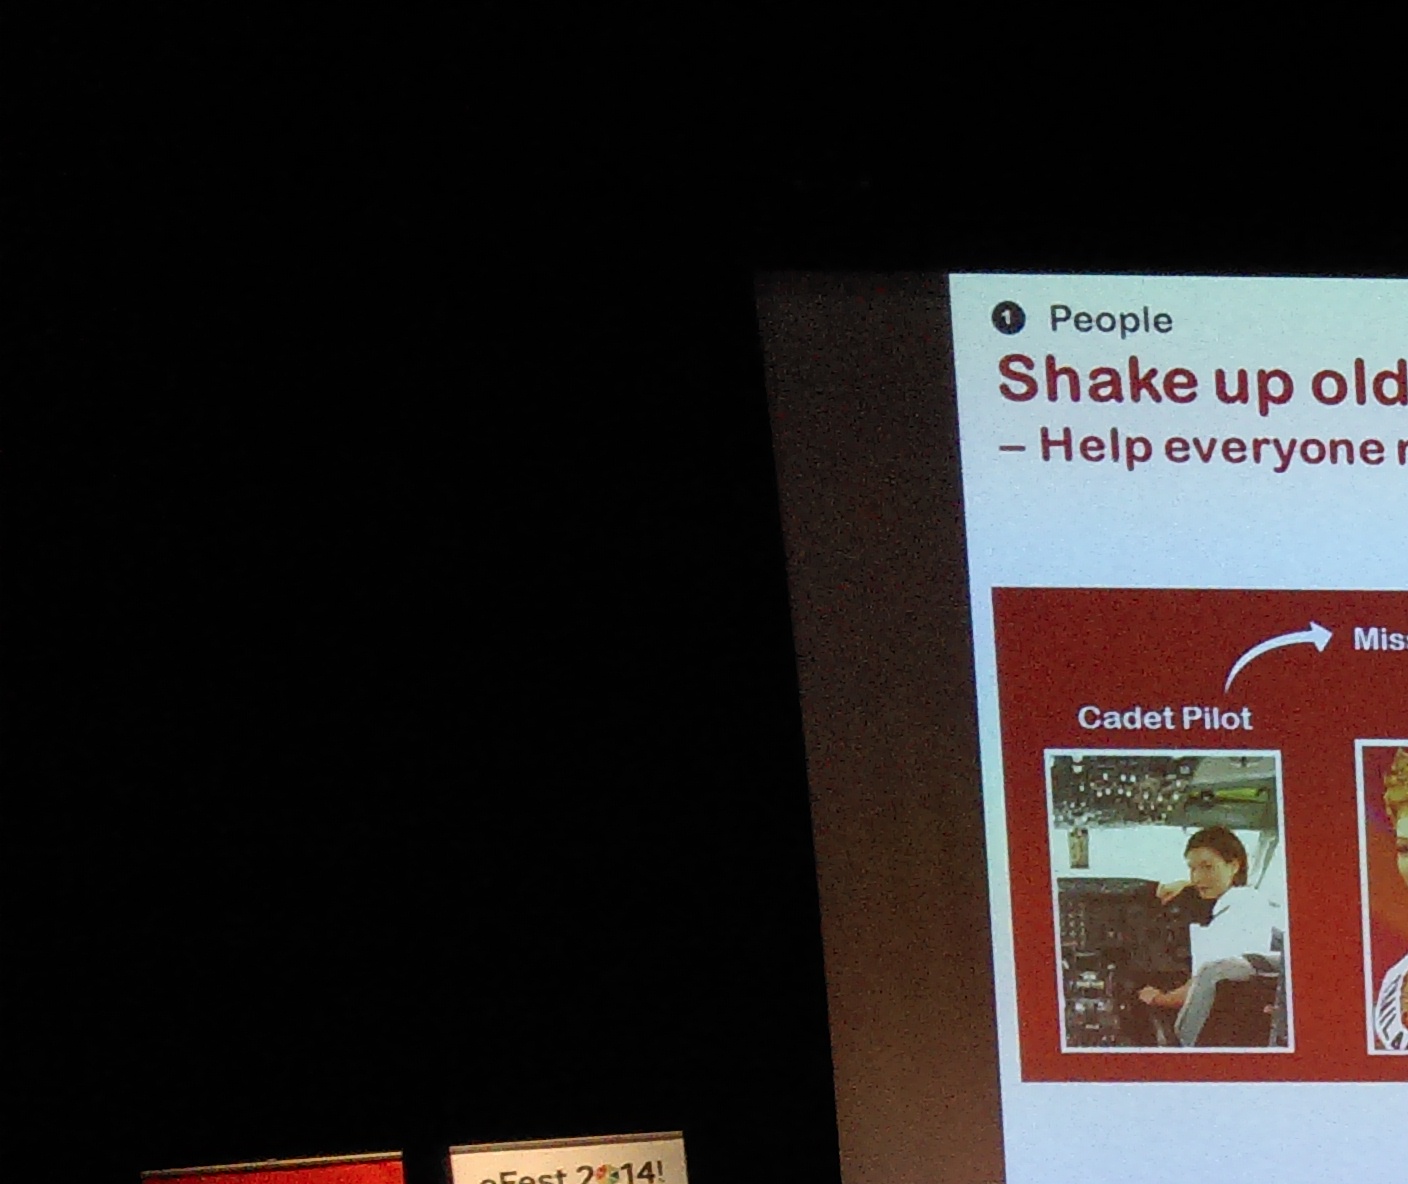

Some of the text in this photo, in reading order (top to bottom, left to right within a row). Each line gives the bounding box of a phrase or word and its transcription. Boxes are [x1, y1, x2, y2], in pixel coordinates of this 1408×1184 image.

[1050, 304, 1173, 339] People
[999, 353, 1198, 404] Shake
[1215, 367, 1294, 417] up
[1311, 357, 1408, 407] old
[1040, 426, 1153, 472] Help
[1164, 434, 1385, 473] everyone
[1077, 706, 1253, 731] Cadet Pilot
